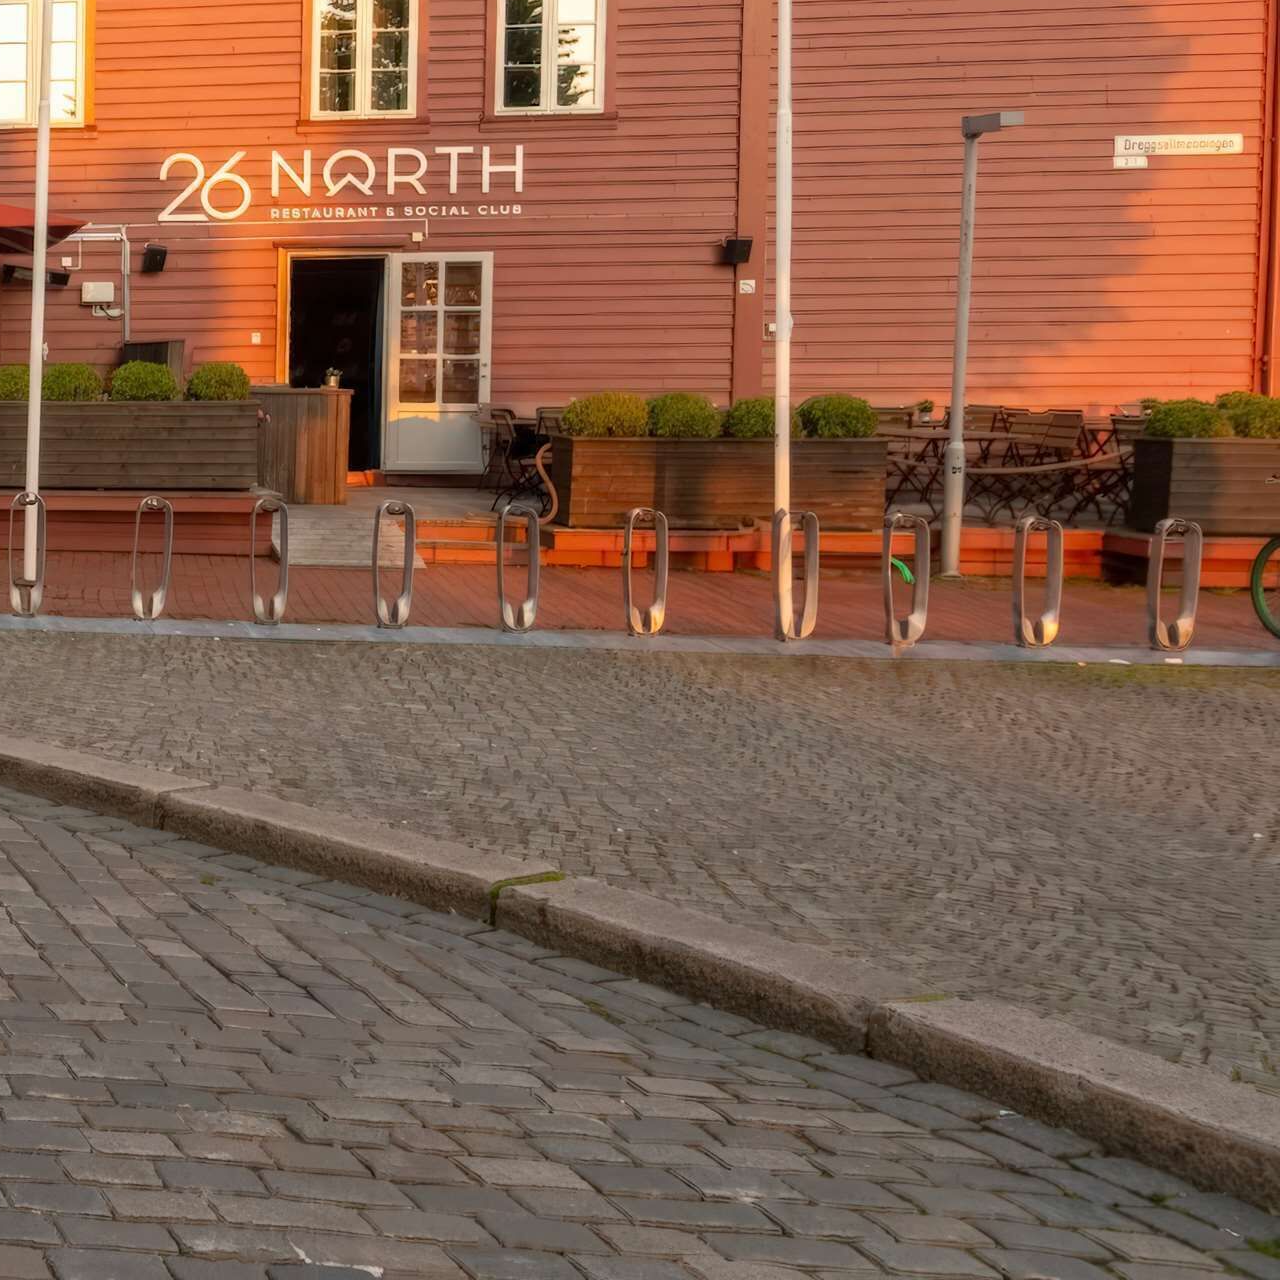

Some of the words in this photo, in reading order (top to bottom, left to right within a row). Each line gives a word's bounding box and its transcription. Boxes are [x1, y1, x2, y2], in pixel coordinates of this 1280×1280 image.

[157, 151, 253, 221] 26
[270, 144, 524, 197] NORTH
[270, 206, 378, 219] RESTAURANT
[403, 204, 470, 217] SOCIAL
[477, 204, 523, 215] CLUB
